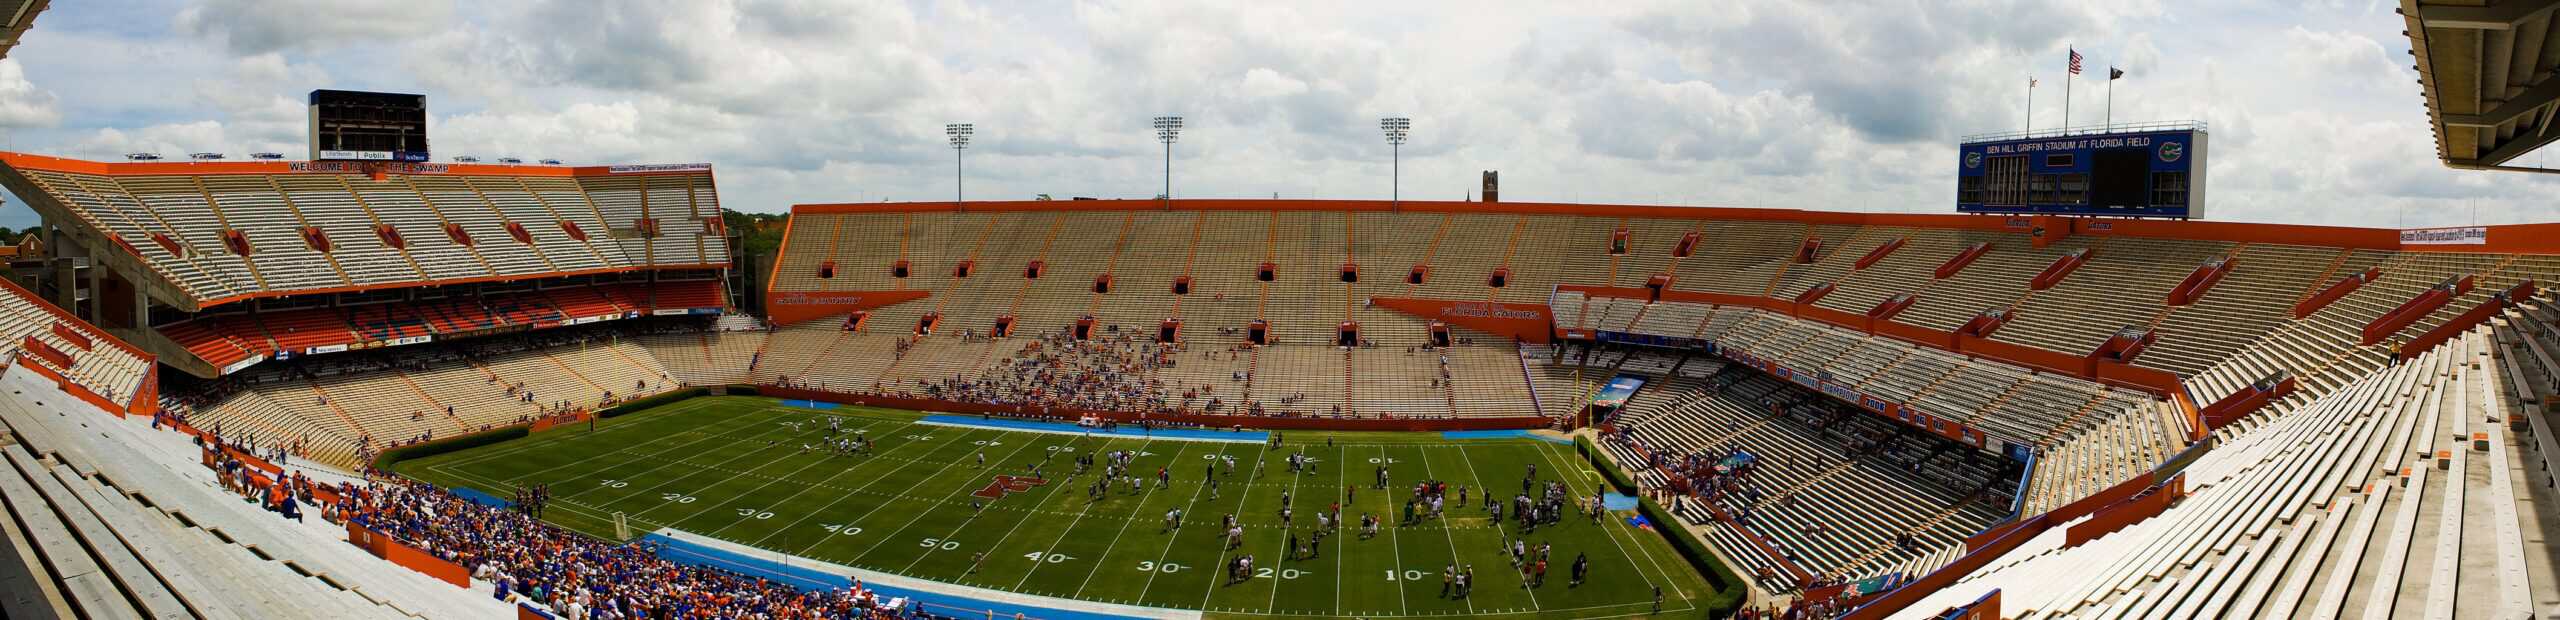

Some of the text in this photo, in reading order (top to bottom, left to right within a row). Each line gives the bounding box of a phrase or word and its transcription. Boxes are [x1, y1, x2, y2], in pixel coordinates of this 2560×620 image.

[1987, 137, 2150, 154] BEN HILL GRIFFIN STADIUM AT FLORIDA FIELD
[289, 162, 449, 173] WELCOME TO THE SWAMP
[1441, 306, 1540, 320] FLORIDA GATORS
[1791, 370, 1861, 403] NATIONAL CHAMPIONS
[663, 492, 697, 504] 20
[738, 508, 776, 520] 30
[824, 523, 863, 536] 40
[919, 538, 961, 551] 50
[1024, 551, 1067, 564] 40
[1136, 561, 1180, 574] 30
[1254, 567, 1300, 580] 20
[1385, 569, 1423, 581] 10
